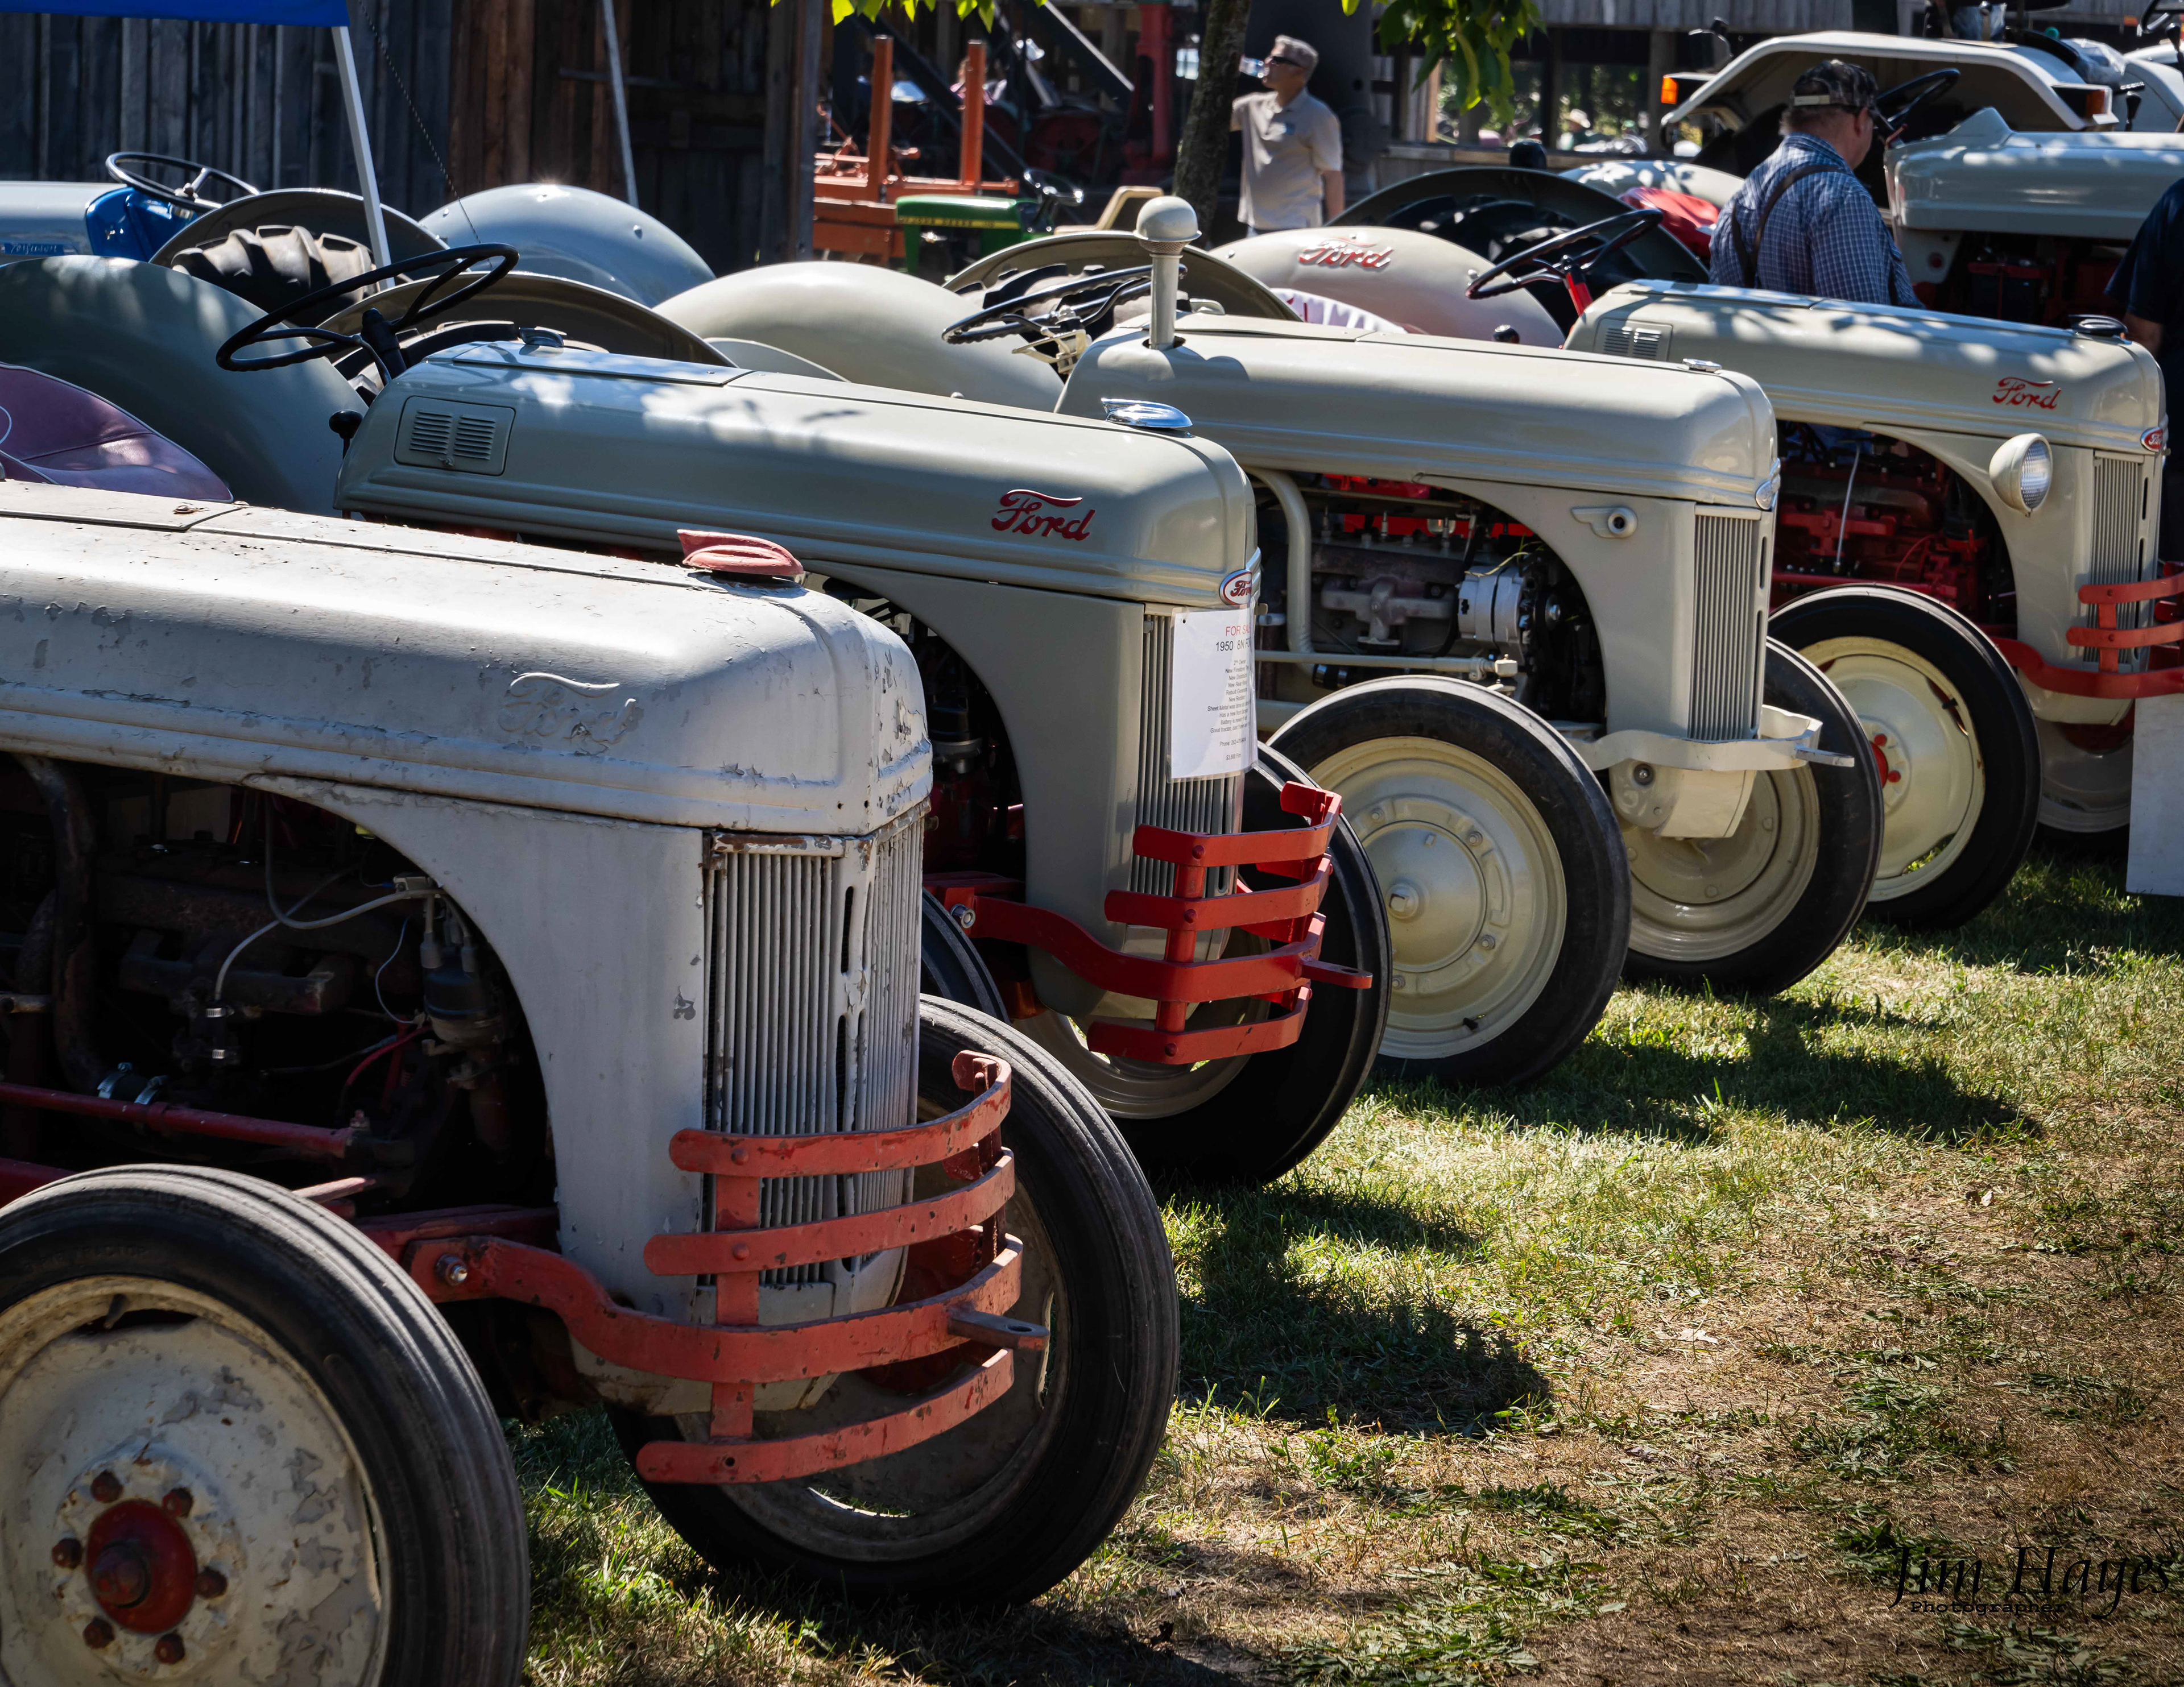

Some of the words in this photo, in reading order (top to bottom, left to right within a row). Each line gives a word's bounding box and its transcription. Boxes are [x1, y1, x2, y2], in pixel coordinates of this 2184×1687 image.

[1298, 236, 1394, 268] Ford
[1992, 376, 2062, 410] Ford
[991, 488, 1097, 541] Ford
[1216, 640, 1234, 652] 1950
[1236, 640, 1244, 650] 8N
[1225, 625, 1241, 636] FOR
